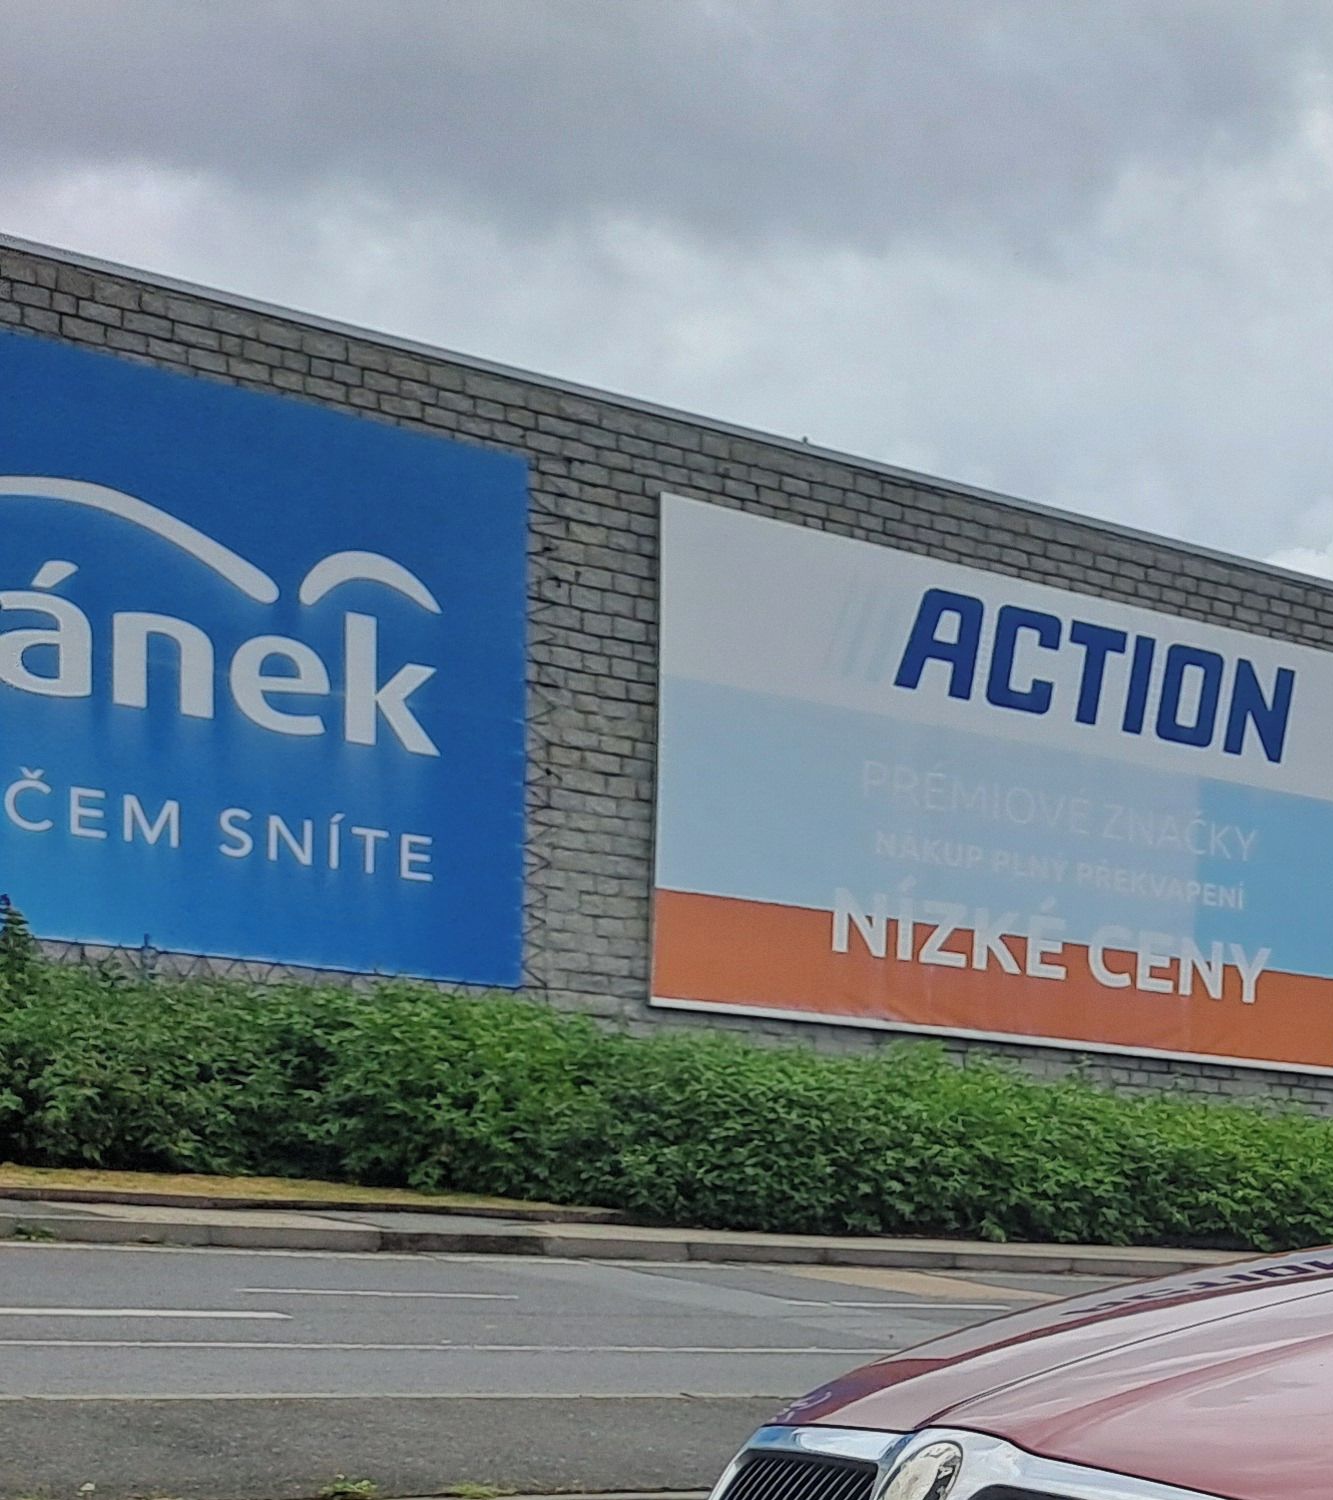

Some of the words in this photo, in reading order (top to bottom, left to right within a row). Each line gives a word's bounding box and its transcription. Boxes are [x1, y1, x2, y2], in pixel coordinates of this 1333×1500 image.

[893, 588, 1296, 764] ACTION
[4, 767, 180, 848] ČEM
[219, 807, 434, 882] SNÍTE
[862, 757, 1091, 835] PRÉMIOVÉ
[1102, 803, 1259, 863] ZNAČKY
[875, 828, 984, 869] NÁKUP
[992, 848, 1069, 884] PLNÝ
[1076, 857, 1245, 910] PŘEKVAPENÍ
[831, 876, 1067, 981] NÍZKÉ
[1087, 924, 1272, 1004] CENY
